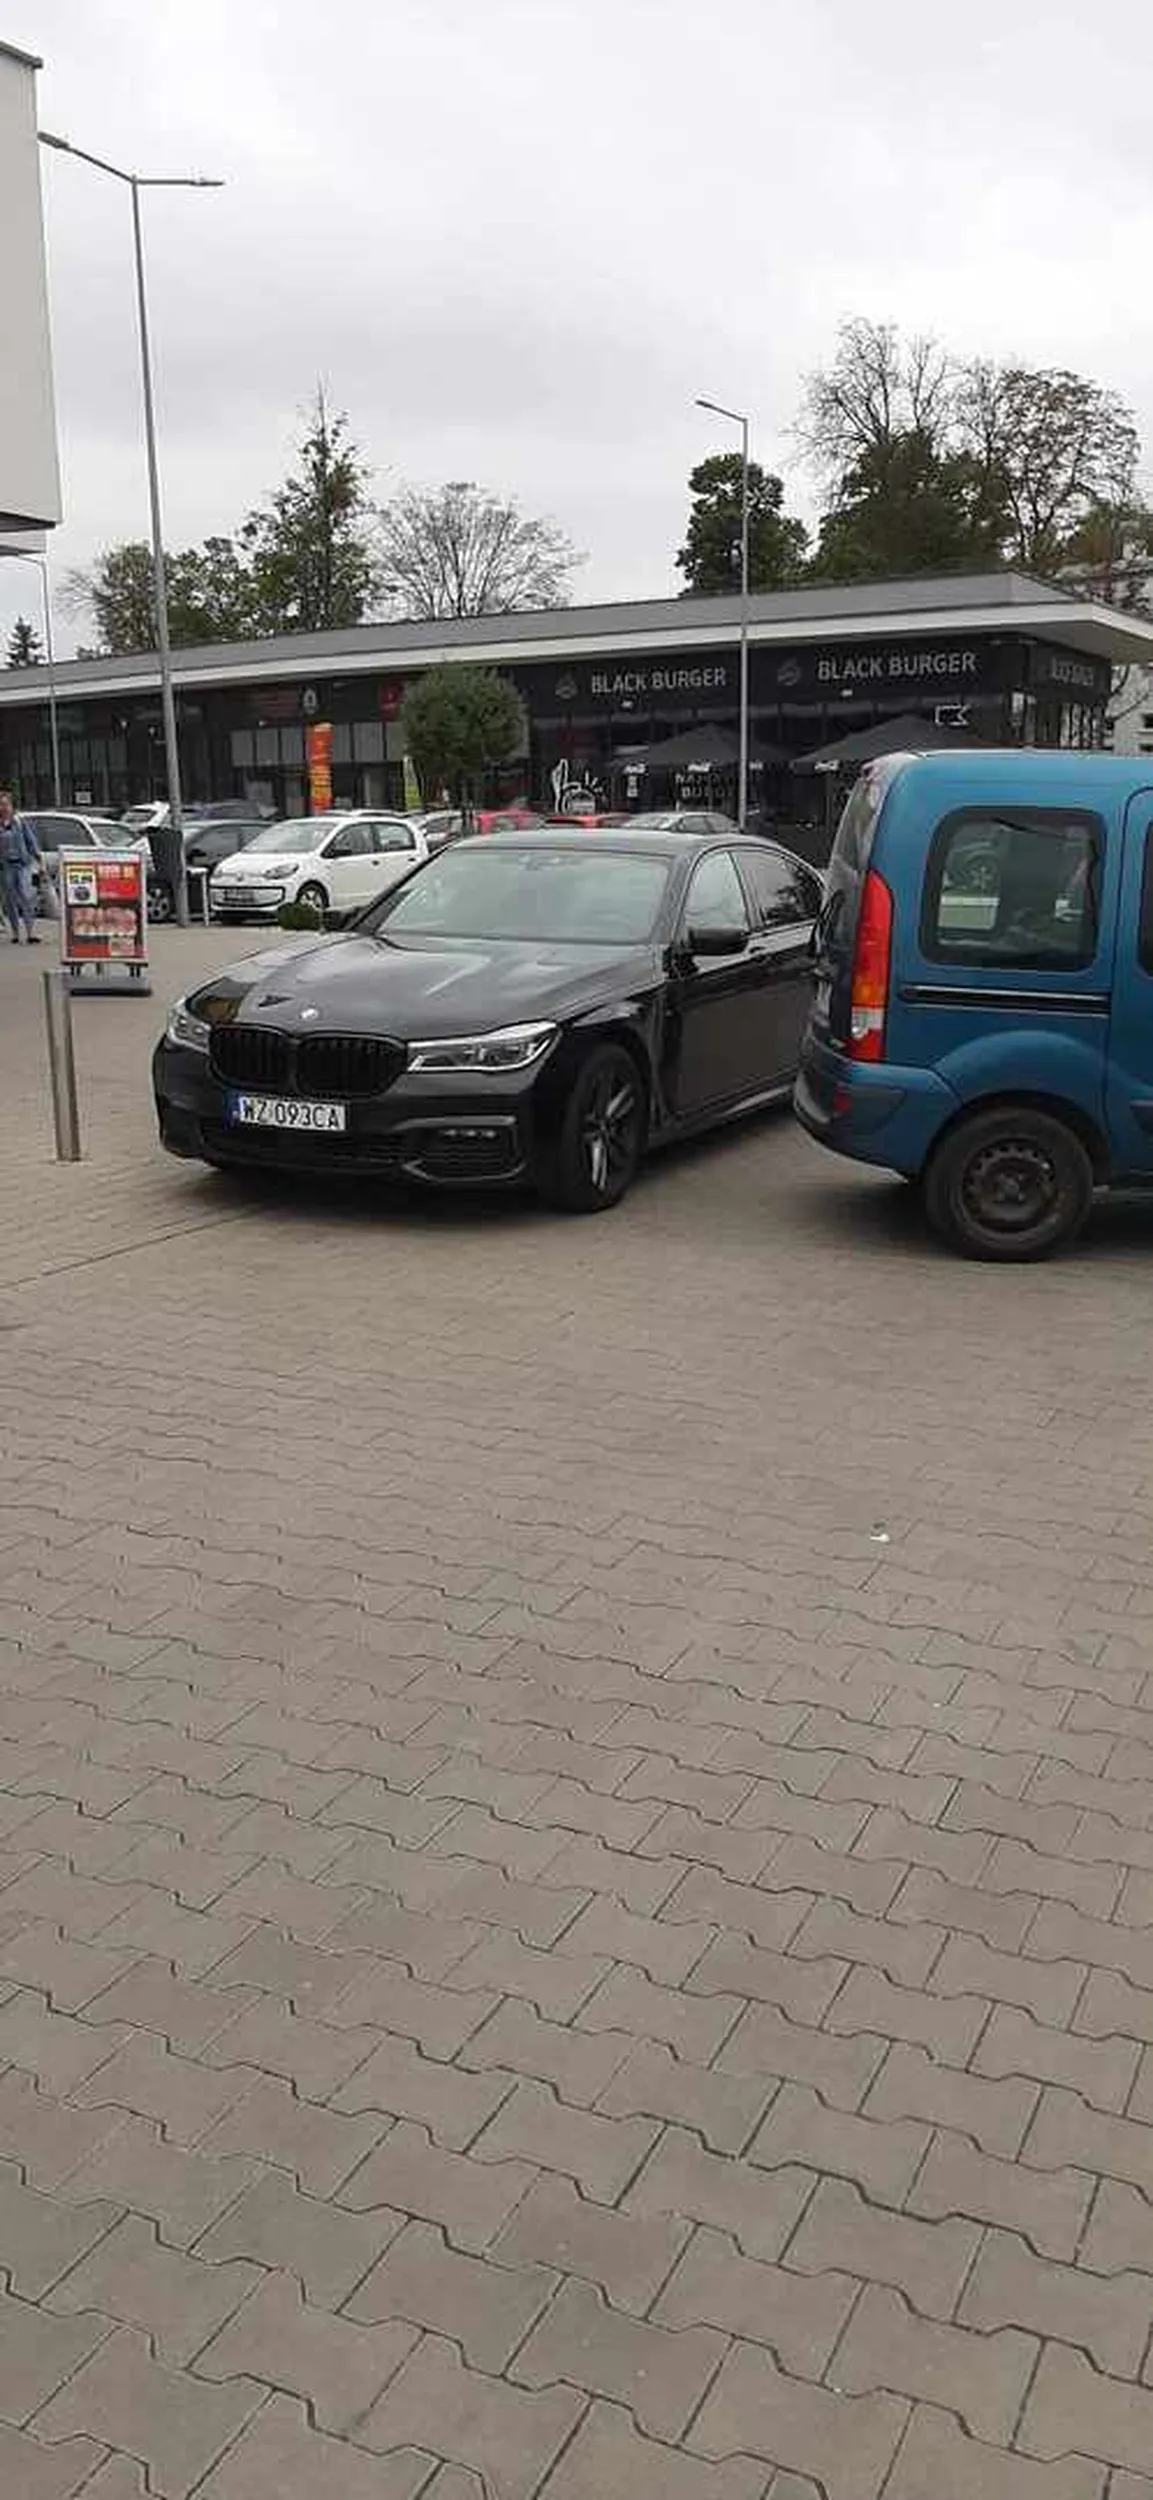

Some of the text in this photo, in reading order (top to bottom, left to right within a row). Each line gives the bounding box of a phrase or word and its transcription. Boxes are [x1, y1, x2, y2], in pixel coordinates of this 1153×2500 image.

[591, 667, 727, 693] BLACK BURGER
[818, 651, 977, 680] BLACK BURGER
[241, 1098, 340, 1128] WZ 093CA
